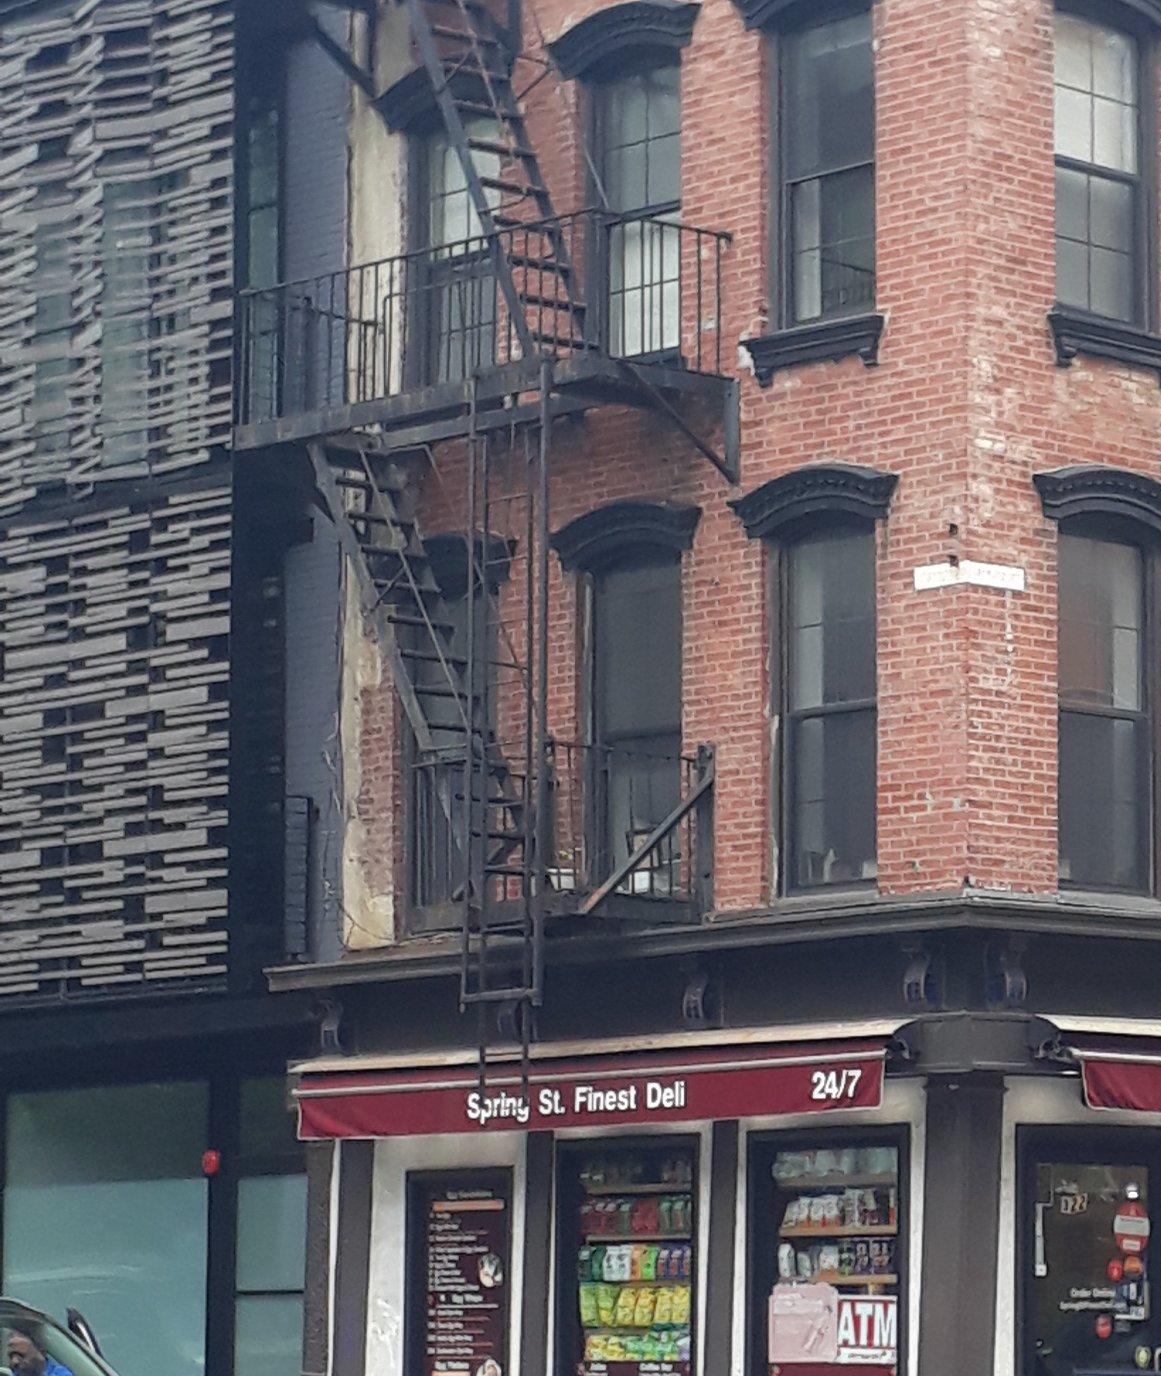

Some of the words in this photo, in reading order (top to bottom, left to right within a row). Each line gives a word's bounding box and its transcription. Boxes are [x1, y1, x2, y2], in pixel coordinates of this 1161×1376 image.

[466, 1092, 530, 1124] Spring
[539, 1088, 566, 1115] St.
[574, 1085, 637, 1113] Finest
[646, 1080, 685, 1109] Deli
[812, 1069, 862, 1100] 24/7
[838, 1301, 896, 1348] ATM
